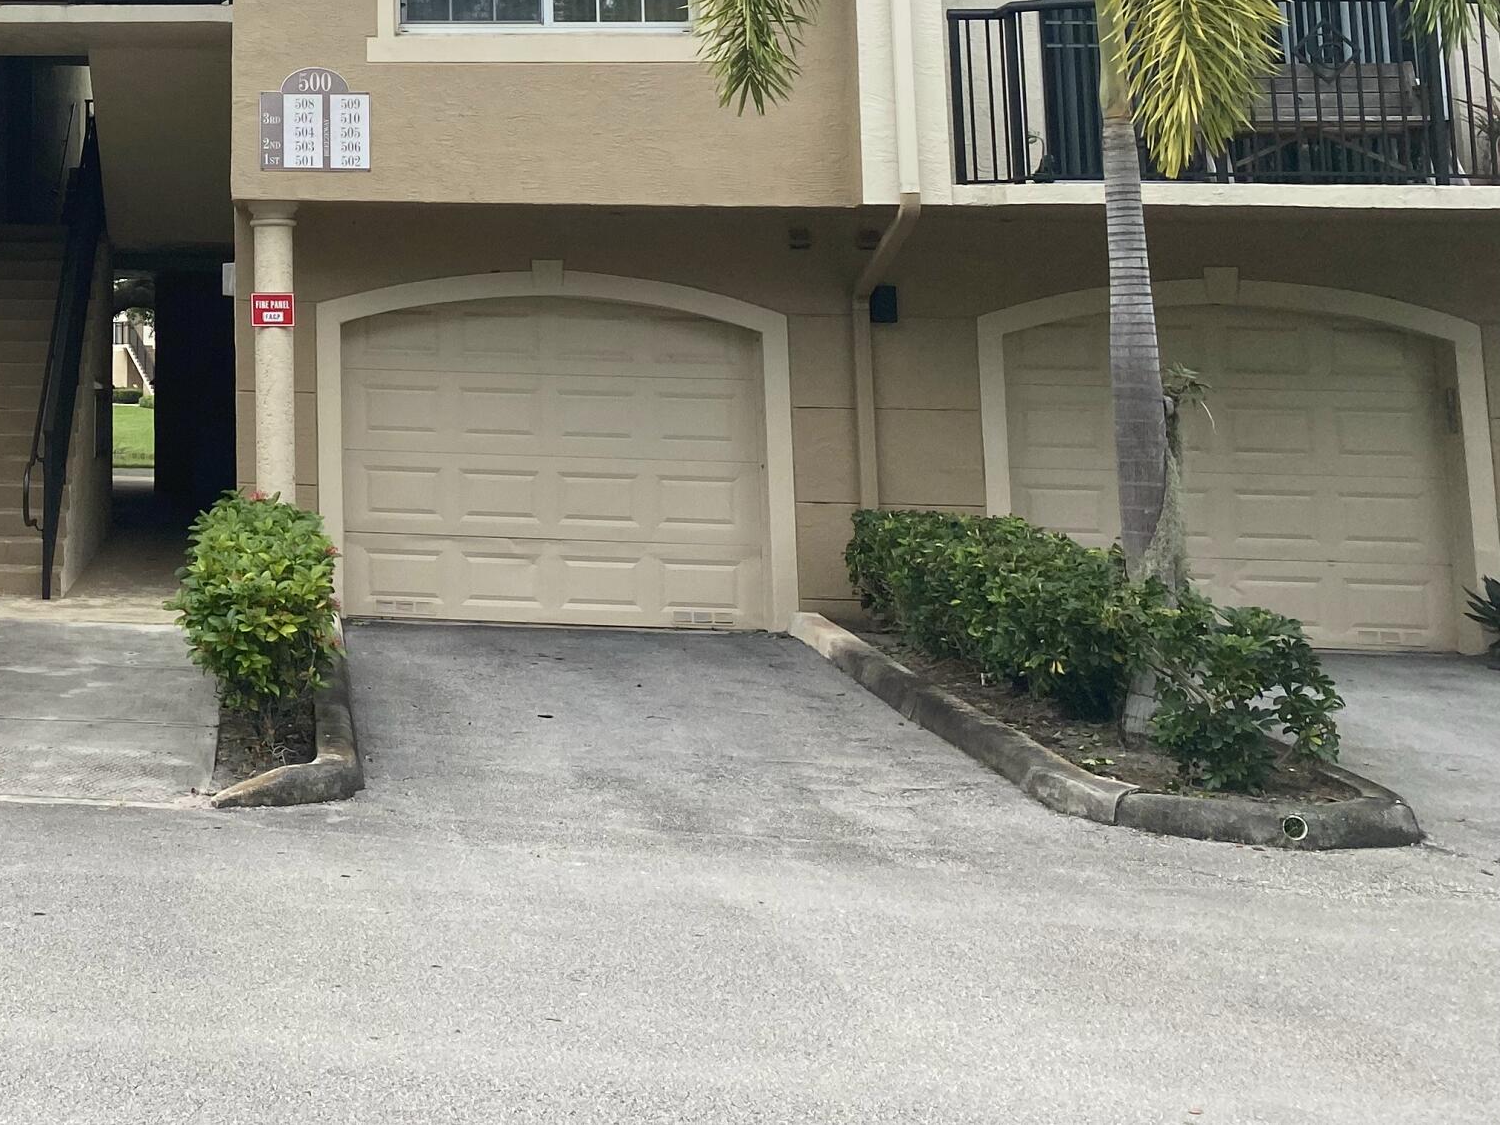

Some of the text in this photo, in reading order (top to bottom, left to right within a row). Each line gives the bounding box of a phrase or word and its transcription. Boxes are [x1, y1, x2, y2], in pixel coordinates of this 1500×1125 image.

[298, 72, 332, 92] 500
[294, 98, 315, 109] 508
[340, 98, 361, 109] 509
[262, 112, 281, 124] 3RD
[293, 112, 314, 123] 507
[340, 112, 360, 123] 510
[294, 126, 315, 138] 504
[340, 126, 361, 138] 505
[262, 138, 281, 149] 2ND
[294, 141, 315, 152] 503
[340, 141, 361, 152] 506
[263, 153, 280, 165] 1ST
[294, 155, 314, 166] 501
[340, 155, 361, 166] 502
[255, 300, 290, 309] FIRE PANEL
